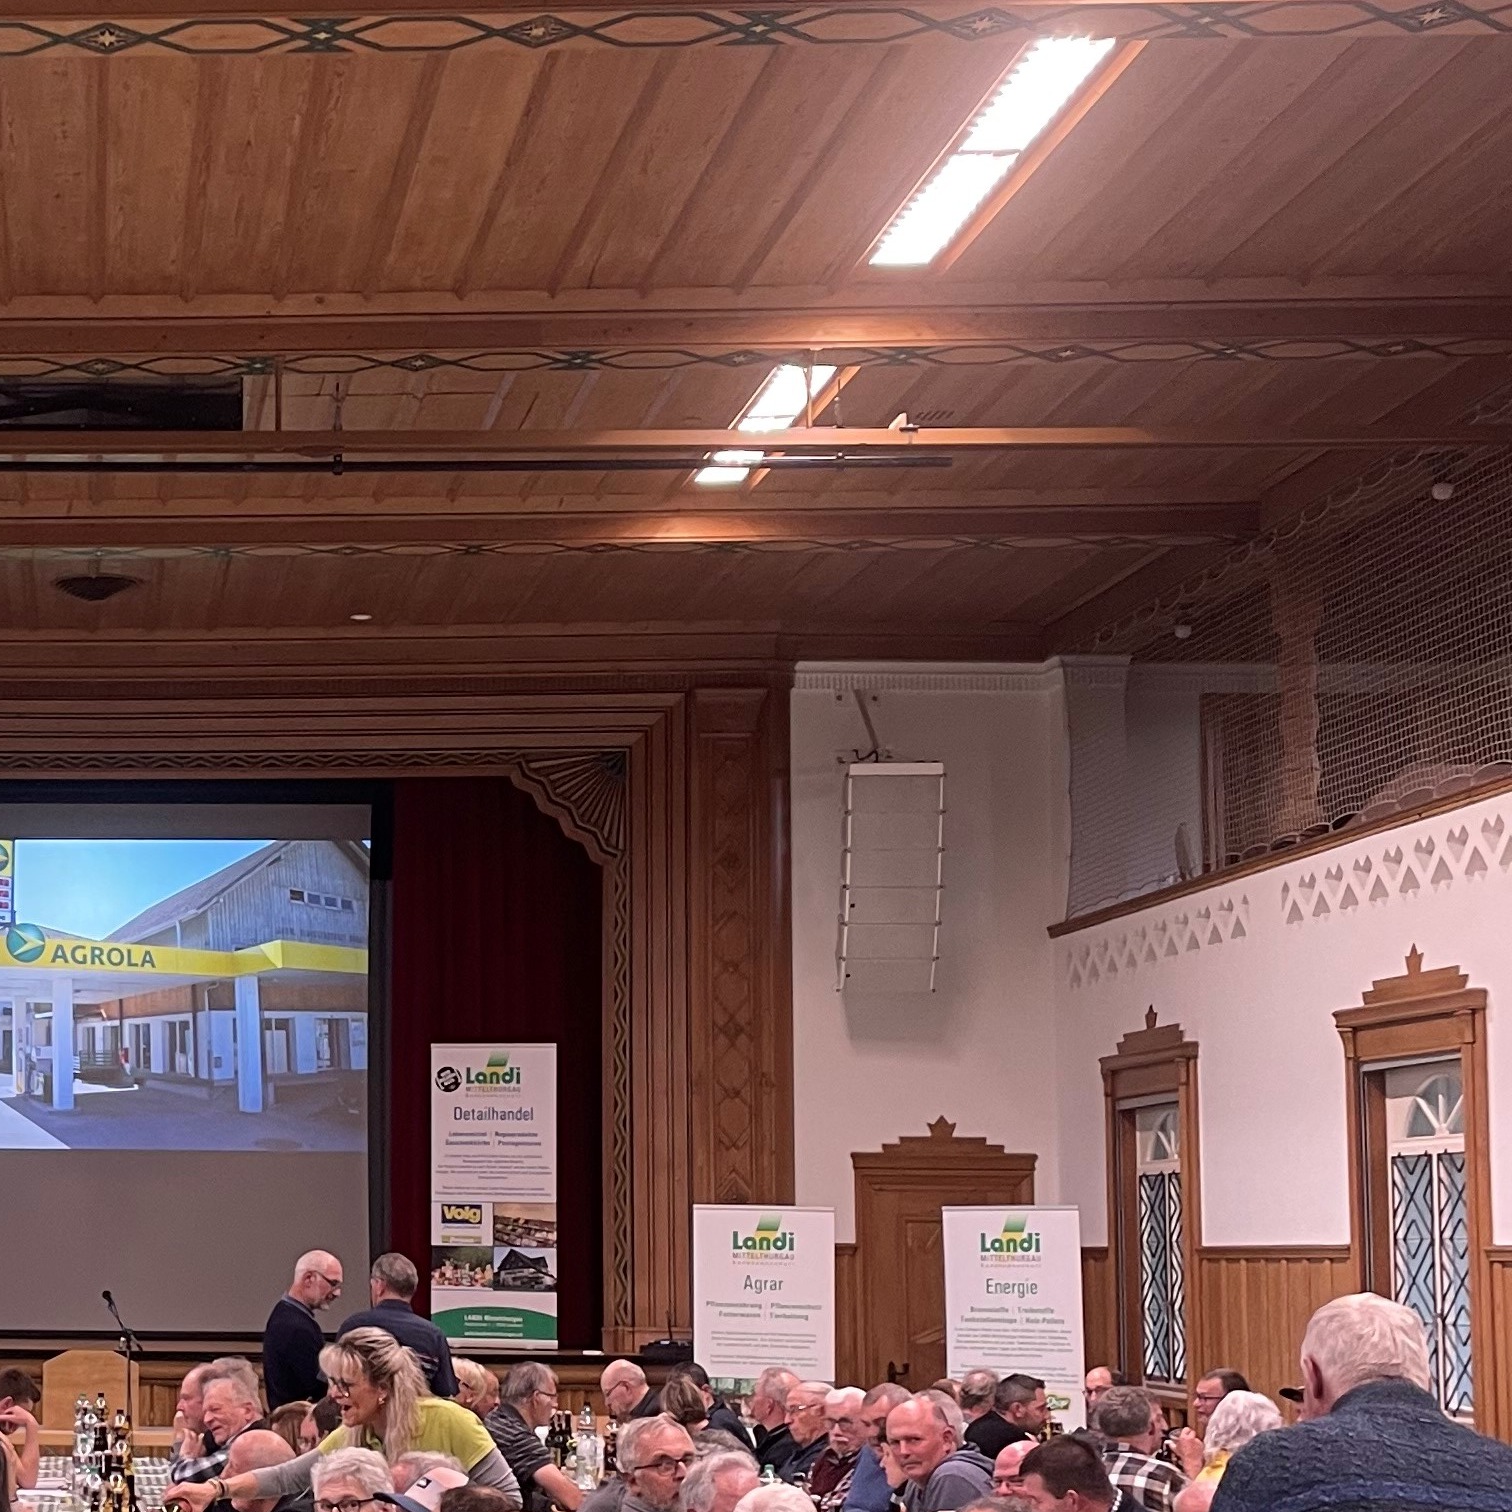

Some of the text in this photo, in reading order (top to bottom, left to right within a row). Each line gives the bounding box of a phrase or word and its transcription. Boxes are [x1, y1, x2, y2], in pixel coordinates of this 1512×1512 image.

[50, 944, 157, 969] AGROLA
[466, 1067, 521, 1084] Landi
[453, 1106, 534, 1121] Detailhandel
[443, 1205, 481, 1223] Volg
[732, 1231, 795, 1251] Landi
[980, 1232, 1041, 1252] Landi
[743, 1275, 784, 1294] Agrar
[985, 1278, 1038, 1298] Energie
